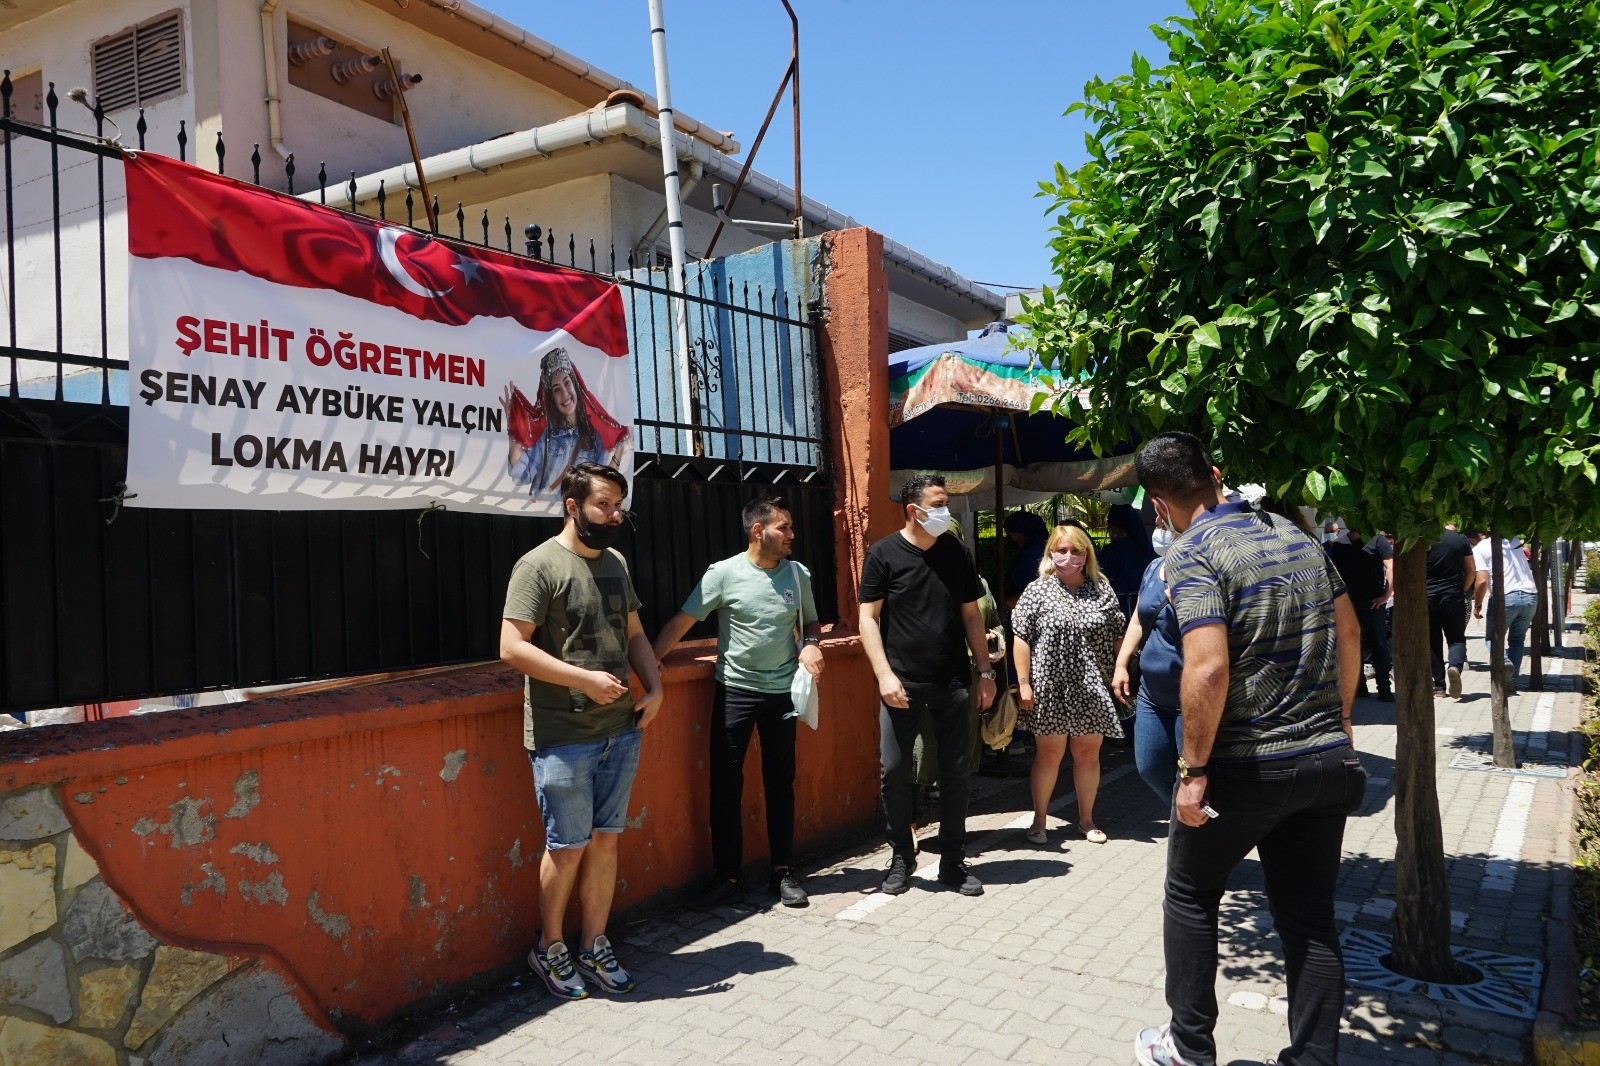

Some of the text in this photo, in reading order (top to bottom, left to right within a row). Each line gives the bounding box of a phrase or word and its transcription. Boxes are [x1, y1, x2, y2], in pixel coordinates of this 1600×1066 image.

[175, 315, 485, 388] ŞEHİT ÖĞRETMEN
[139, 369, 501, 434] ŞENAY AYBÜKE YALÇIN
[977, 394, 1000, 405] 0266
[1003, 398, 1020, 408] 244
[211, 432, 455, 477] LOKMA HAYRI
